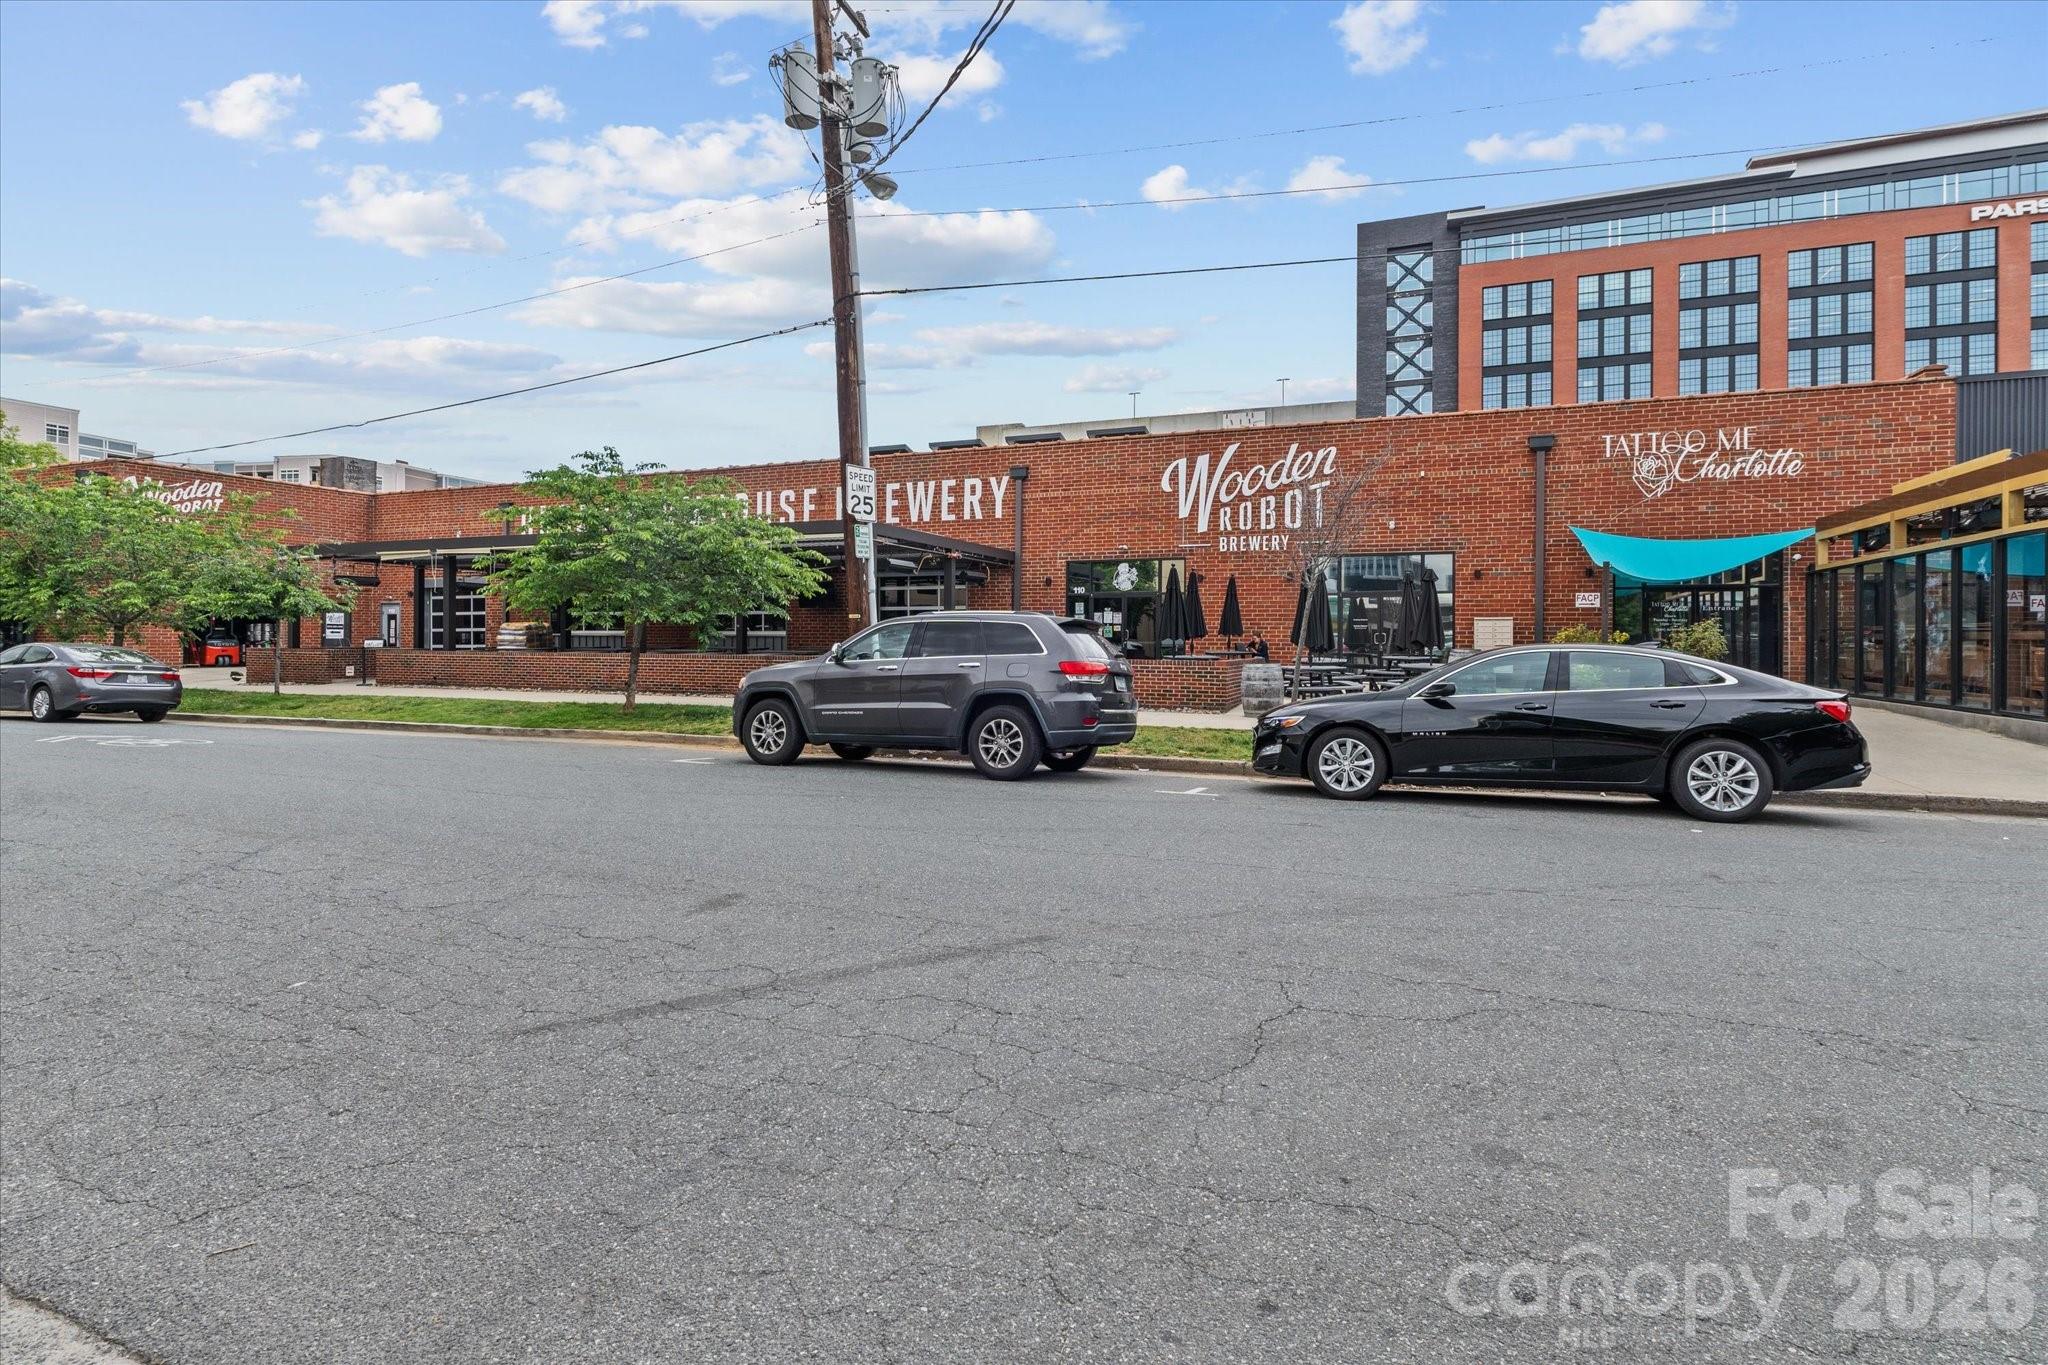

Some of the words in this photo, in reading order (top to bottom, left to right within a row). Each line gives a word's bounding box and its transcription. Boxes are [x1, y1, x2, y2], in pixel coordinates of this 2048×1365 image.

[1601, 430, 1706, 458] TATTOO
[1718, 426, 1757, 450] ME
[849, 472, 873, 483] SPEED
[1674, 447, 1804, 482] Charlotte
[836, 475, 1009, 524] EWERY
[851, 484, 871, 493] LIMIT
[1161, 442, 1337, 533] Wooden
[851, 494, 873, 515] 25
[1219, 480, 1331, 531] ROBOT
[1219, 535, 1290, 551] BREWERY
[1576, 594, 1599, 602] FACP
